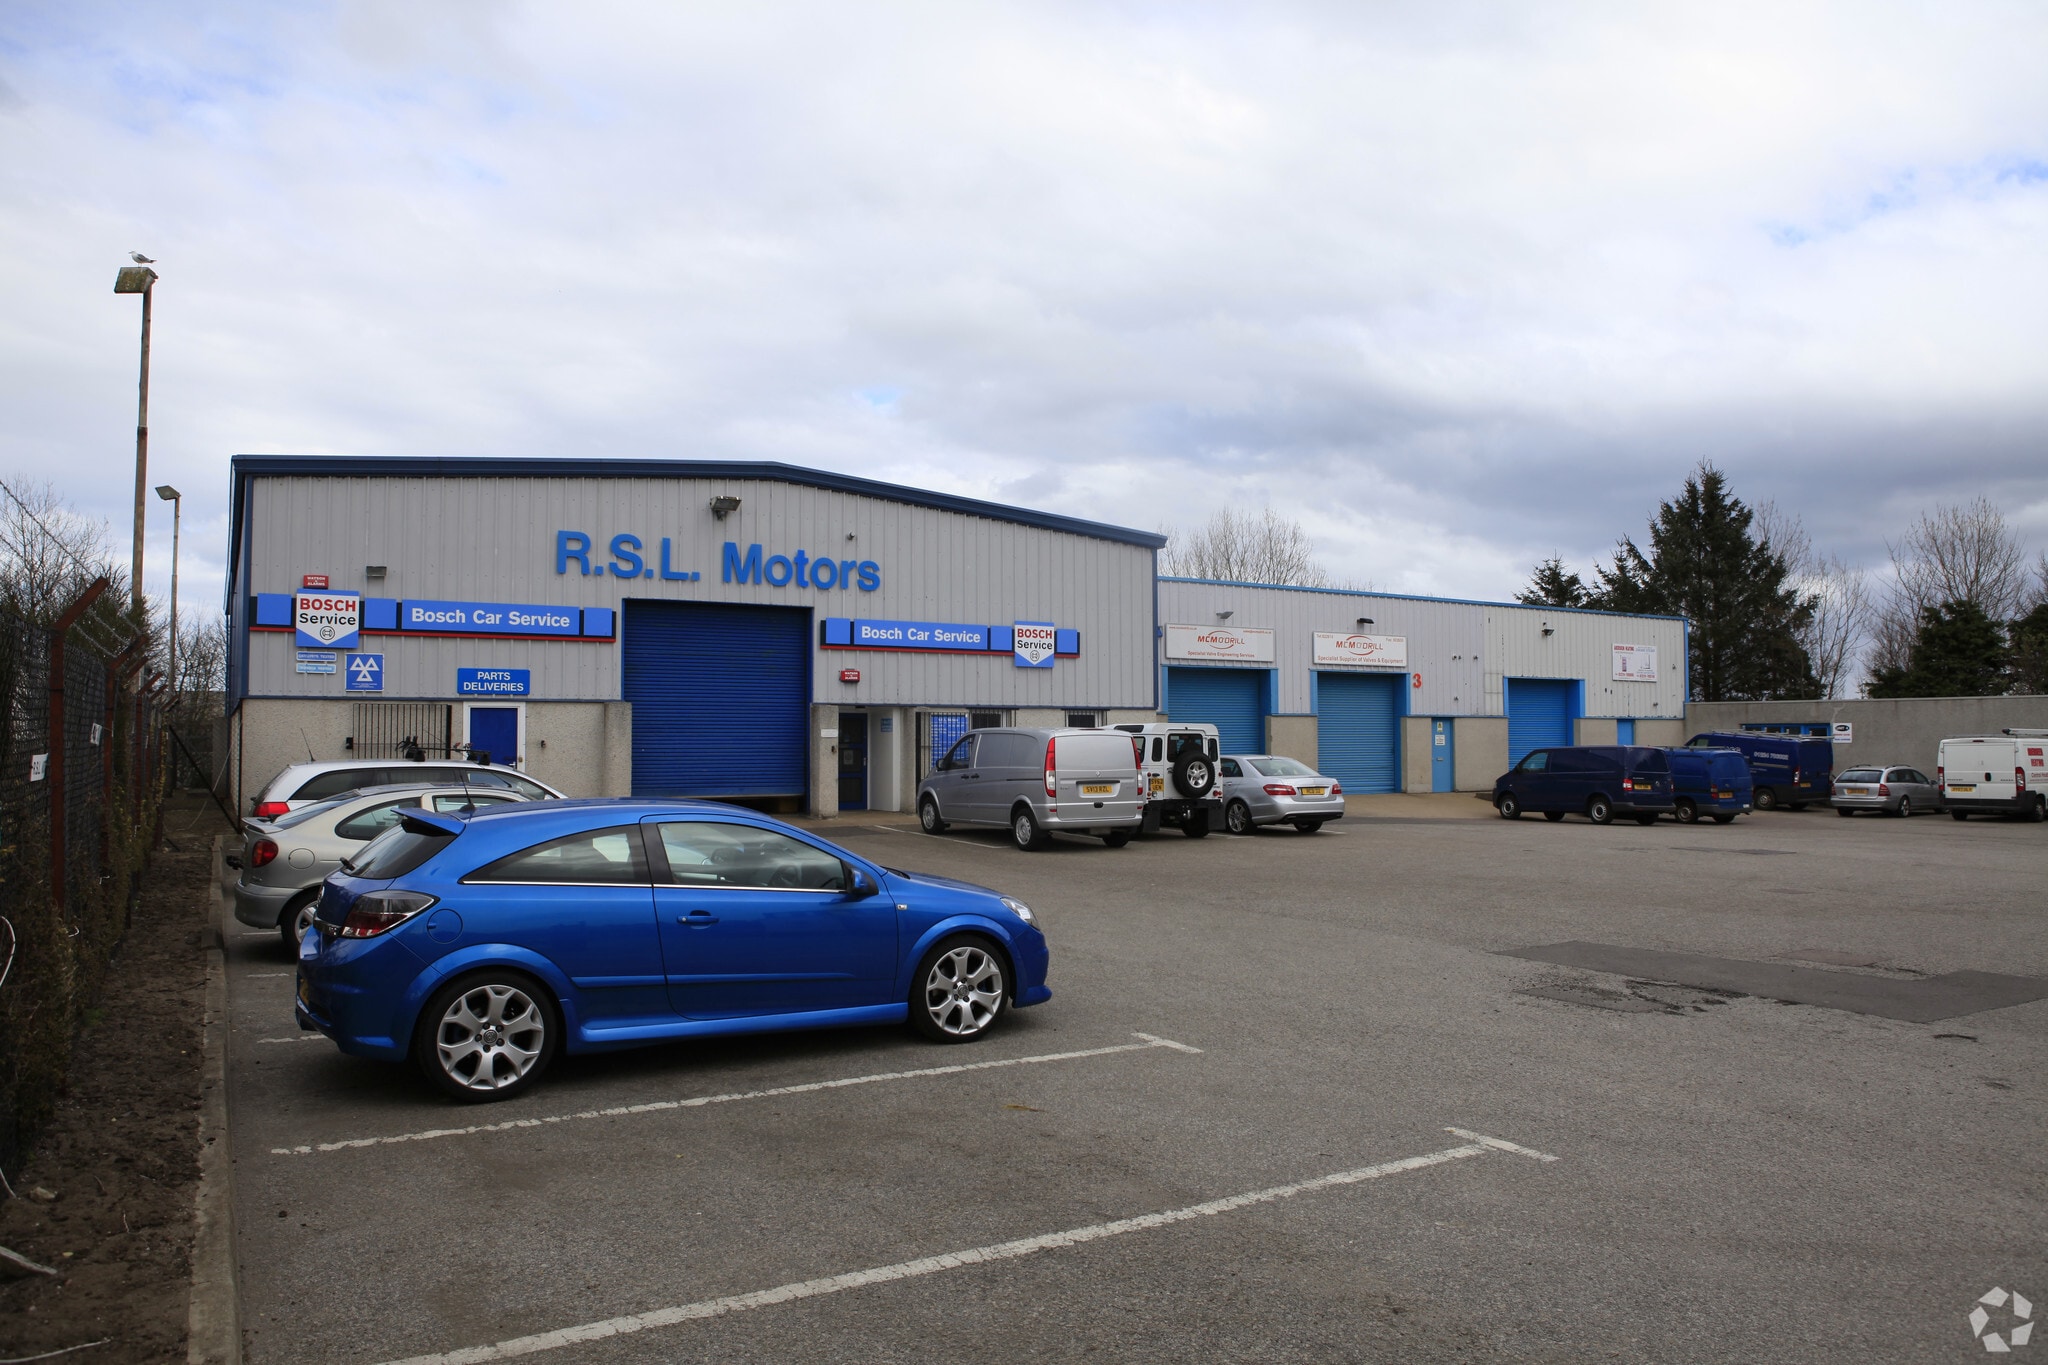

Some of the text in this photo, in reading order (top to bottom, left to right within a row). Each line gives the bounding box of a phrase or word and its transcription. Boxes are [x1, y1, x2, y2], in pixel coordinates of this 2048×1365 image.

[557, 530, 881, 592] R.S.L. Motors
[299, 598, 356, 612] BOSCH
[299, 612, 356, 626] Service
[411, 607, 570, 627] Bosch Car Service
[861, 626, 981, 644] Bosch Car Service
[1017, 628, 1053, 639] BOSCH
[1017, 640, 1053, 650] Service
[477, 671, 511, 681] PARTS
[1412, 673, 1422, 689] 3
[463, 682, 524, 692] DELIVERIES
